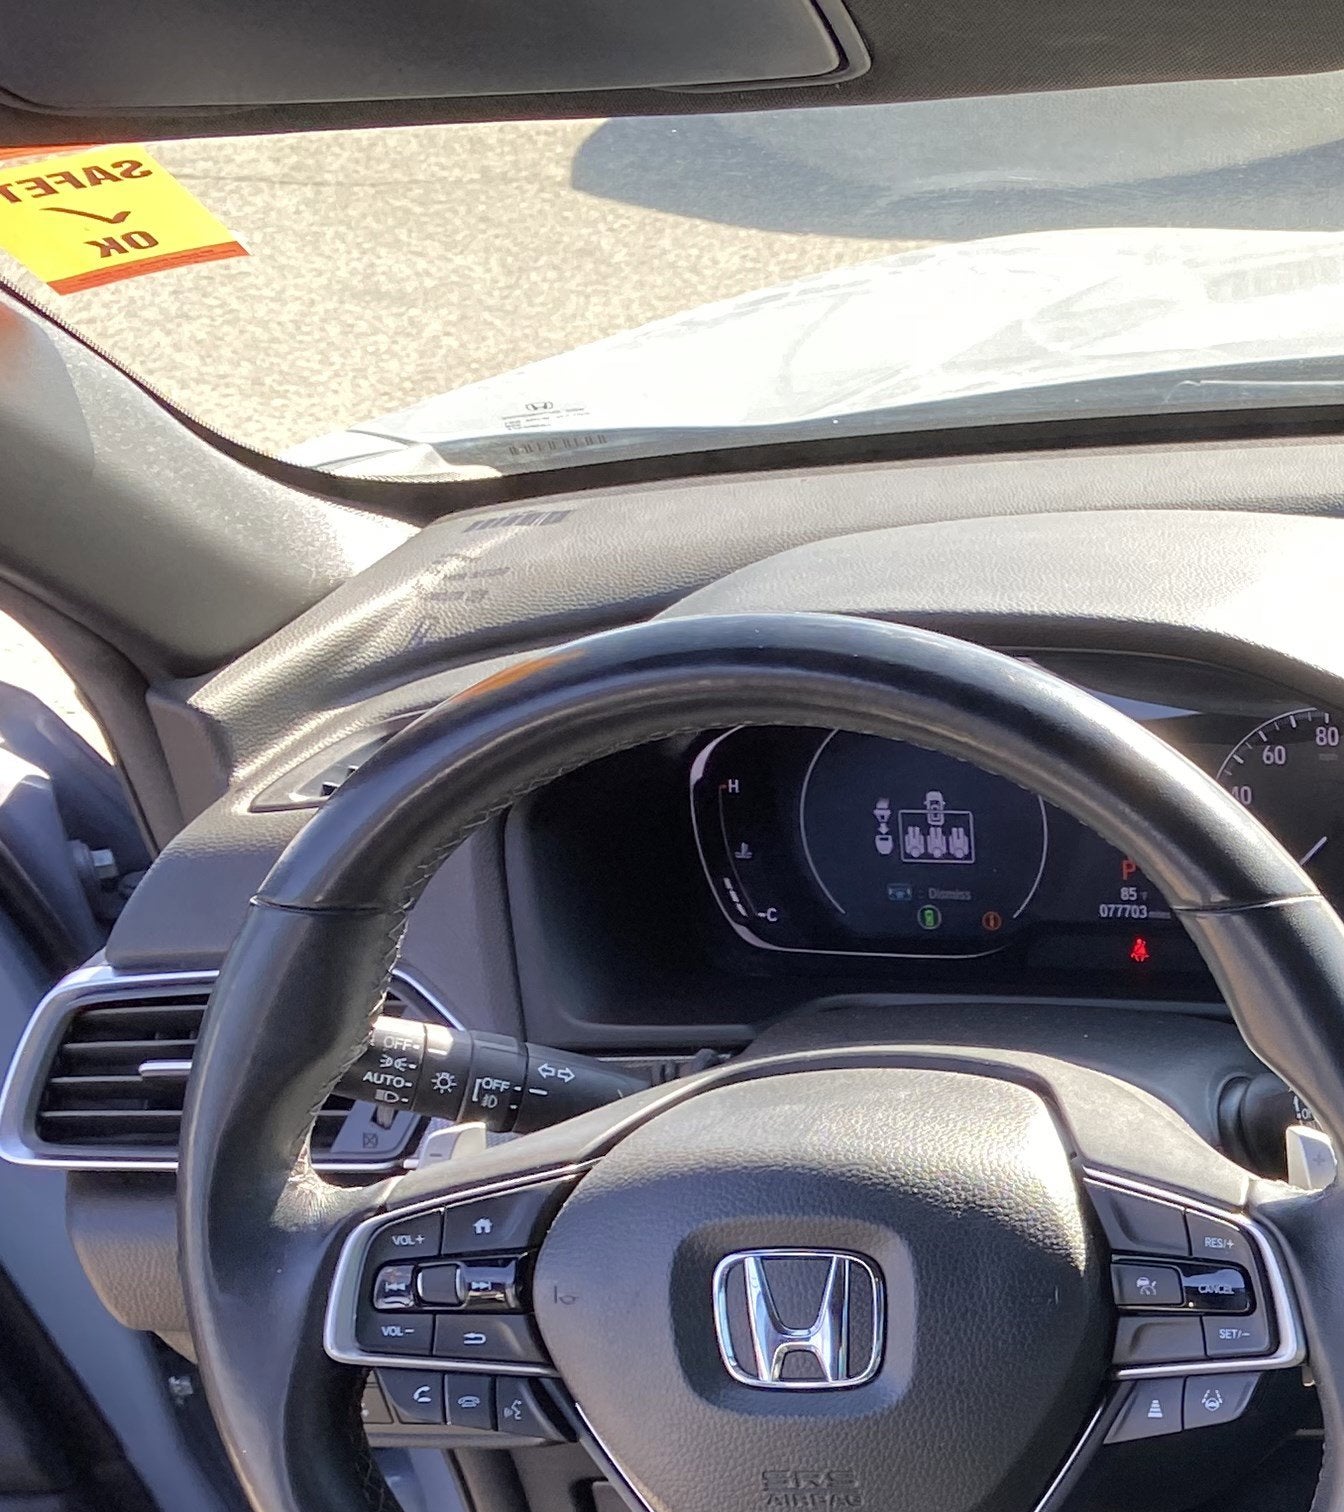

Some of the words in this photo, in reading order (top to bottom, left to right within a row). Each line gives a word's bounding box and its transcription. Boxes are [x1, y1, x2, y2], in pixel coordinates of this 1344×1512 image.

[1315, 727, 1339, 746] 80
[1262, 745, 1286, 765] 60
[728, 779, 740, 794] H
[1120, 887, 1137, 900] 85
[767, 908, 778, 922] C
[1099, 904, 1148, 918] 077703
[383, 1036, 412, 1050] OFF
[363, 1071, 405, 1088] AUTO
[482, 1077, 510, 1092] OFF
[1198, 1285, 1234, 1295] CANCEL
